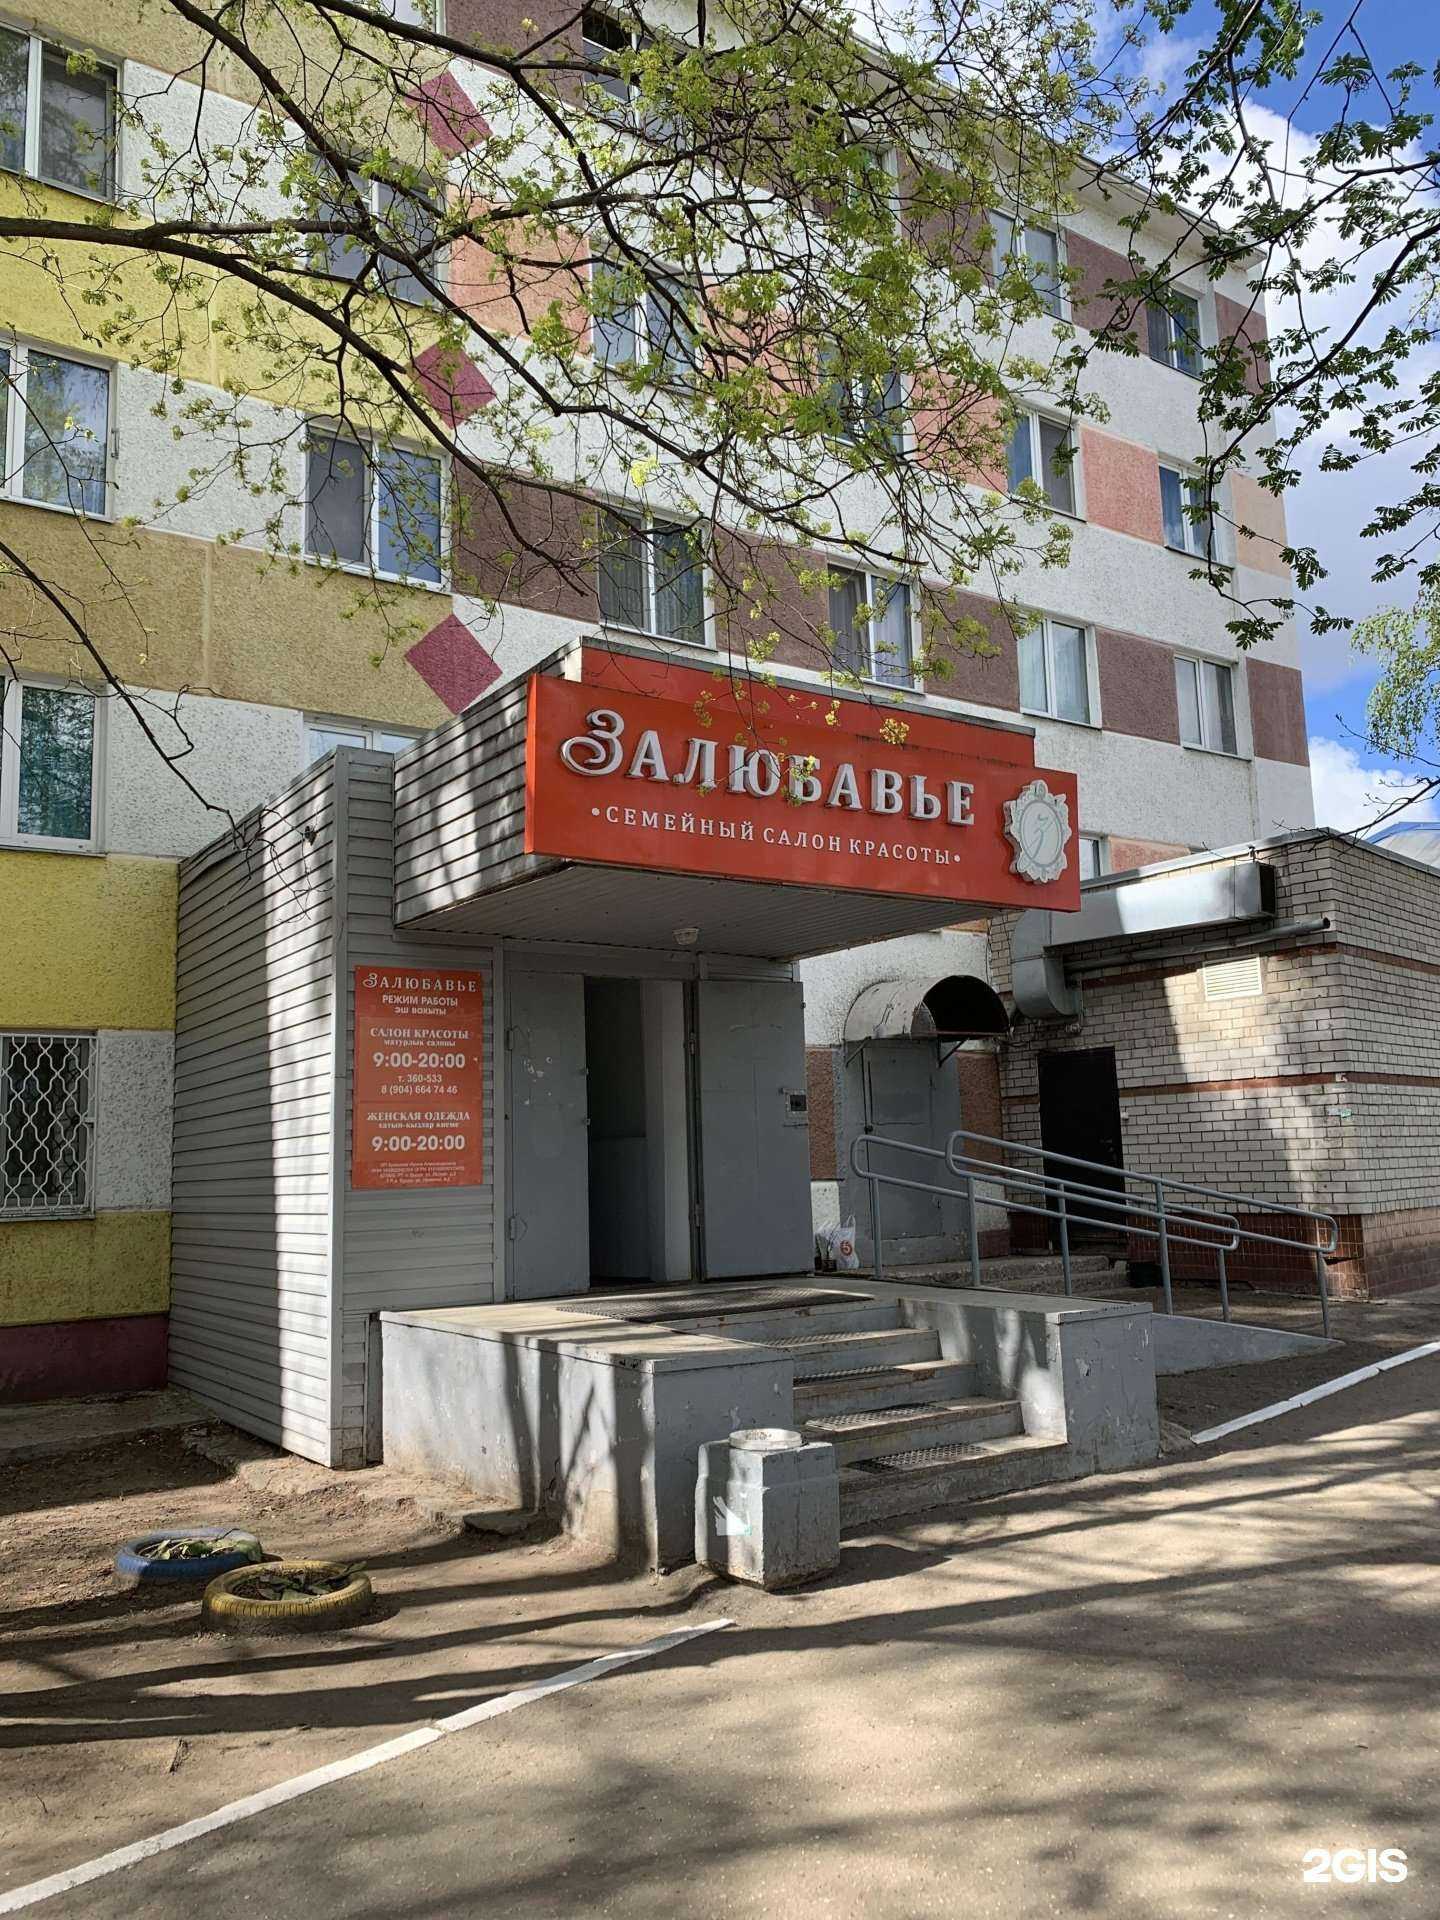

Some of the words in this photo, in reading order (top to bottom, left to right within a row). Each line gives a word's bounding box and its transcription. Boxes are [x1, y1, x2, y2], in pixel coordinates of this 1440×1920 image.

[560, 709, 976, 826] ЗАЛЮБАВЬЕ
[606, 805, 754, 842] СЕМЕЙНЫЙ
[763, 827, 842, 853] САЛОН
[849, 839, 950, 866] КРАСОТЫ
[362, 972, 477, 993] ЗАЛЮБАВЬЕ
[382, 994, 419, 1005] РЕЖИМ
[421, 996, 458, 1007] РАБОТЫ
[370, 1027, 411, 1038] САЛОН
[414, 1029, 469, 1040] КРАСОТЫ
[373, 1052, 466, 1068] 9:00-20:00
[367, 1111, 421, 1121] ЖЕНСКАЯ
[424, 1111, 470, 1121] ОДЕЖДА
[371, 1134, 465, 1152] 9:00-20:00
